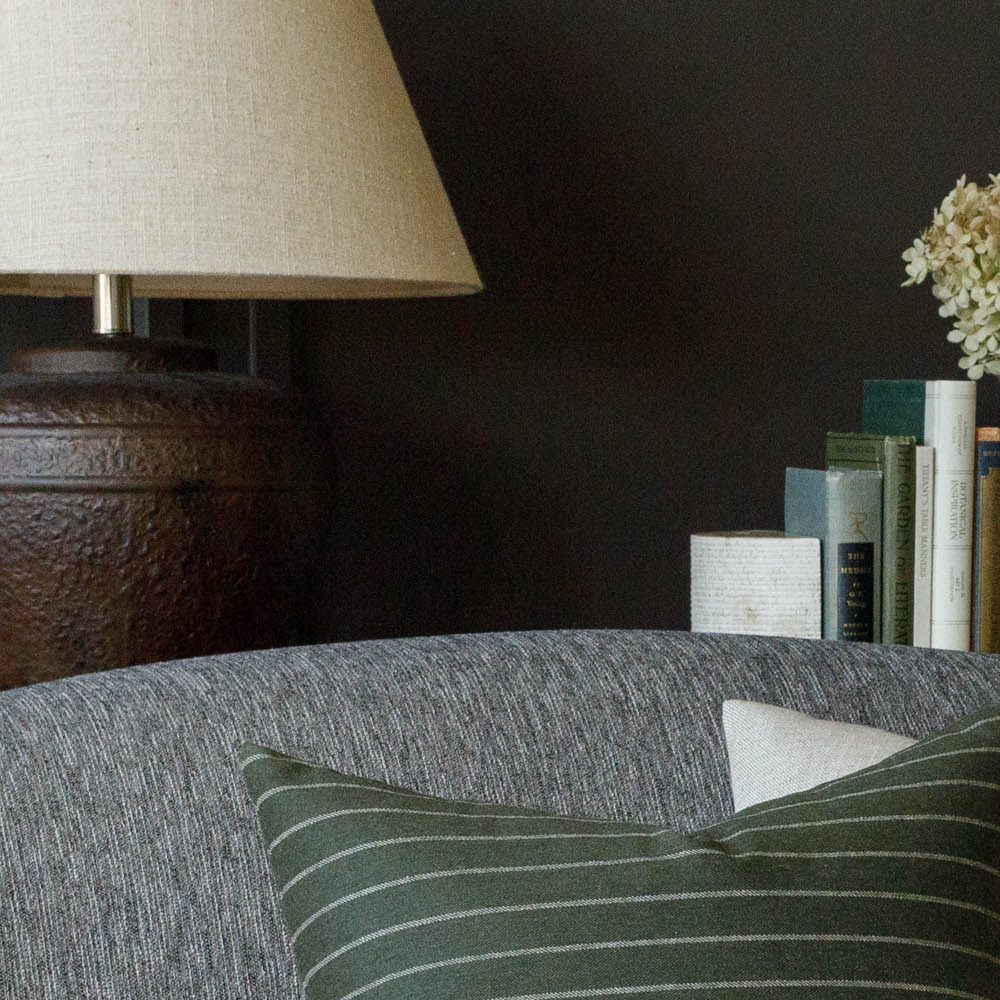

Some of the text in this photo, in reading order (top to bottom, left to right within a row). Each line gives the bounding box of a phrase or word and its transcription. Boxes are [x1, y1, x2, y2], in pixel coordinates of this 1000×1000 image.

[895, 482, 913, 549] GARDEN
[919, 464, 930, 578] TIFFANY'S TABLE MANNERS
[950, 479, 960, 541] INSPIRATION
[958, 480, 969, 539] BOTANICAL
